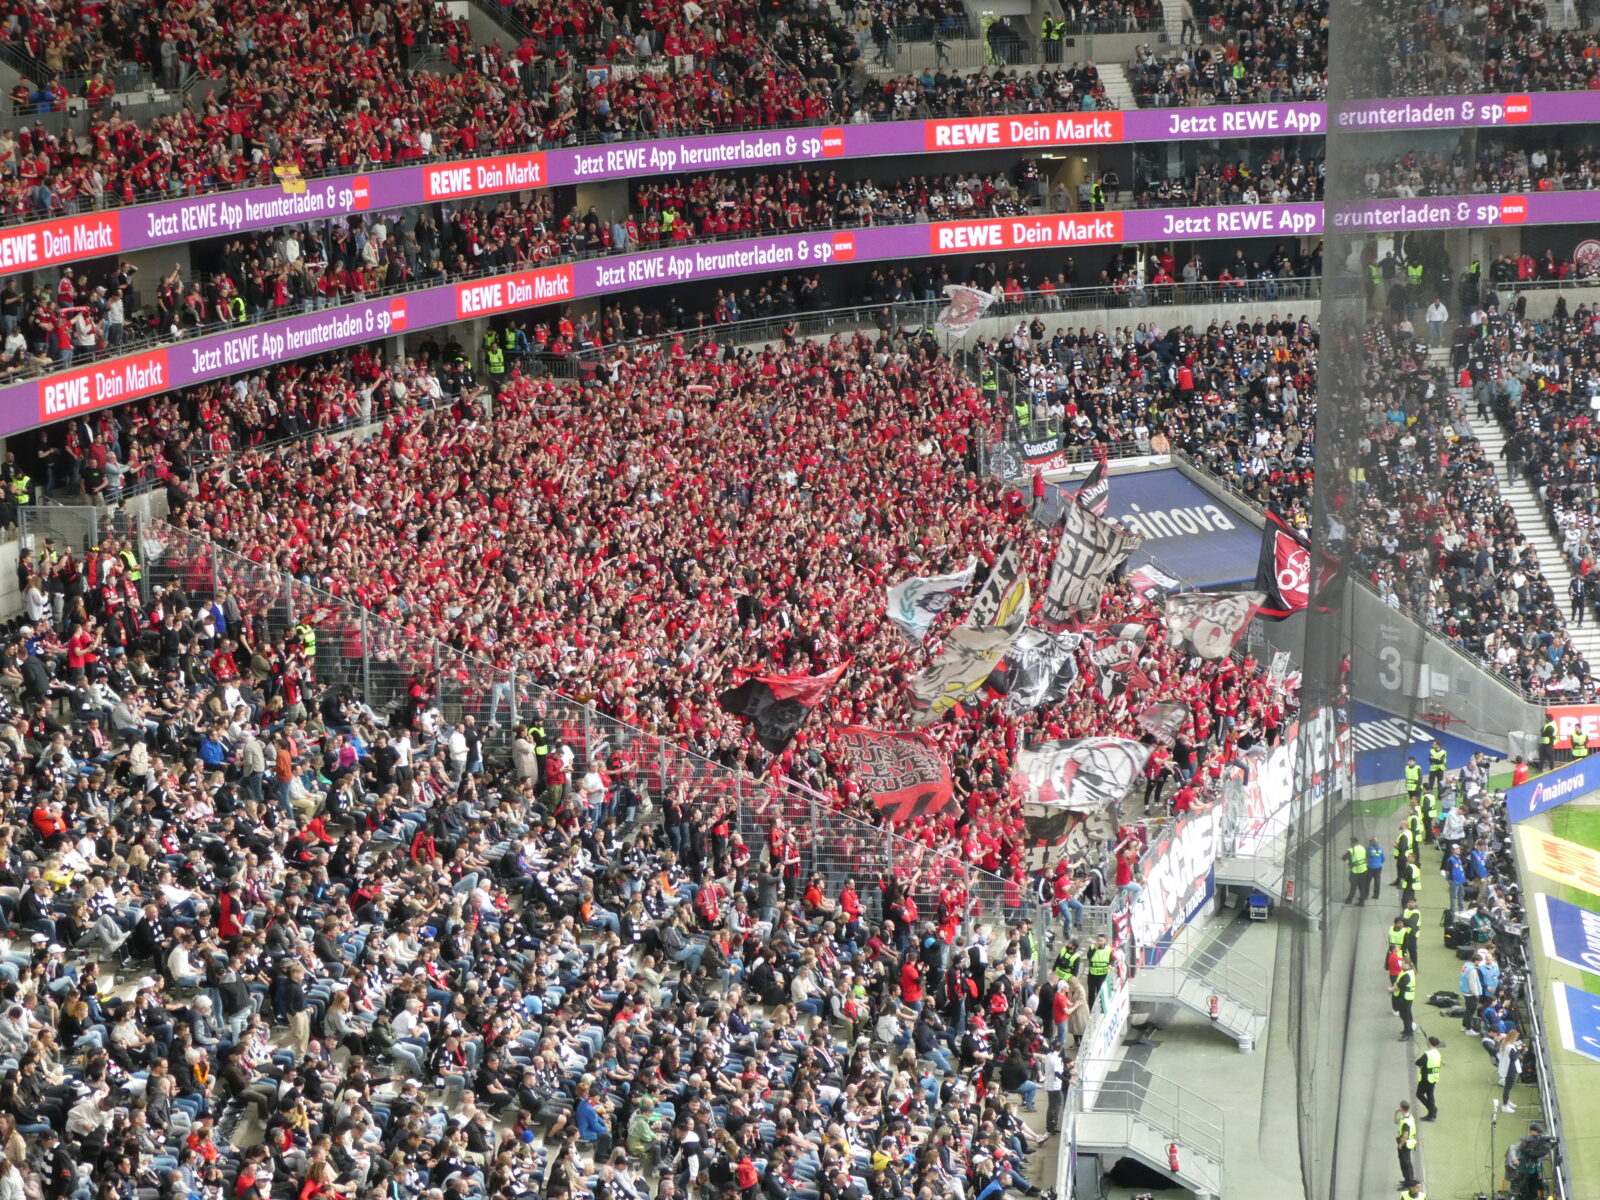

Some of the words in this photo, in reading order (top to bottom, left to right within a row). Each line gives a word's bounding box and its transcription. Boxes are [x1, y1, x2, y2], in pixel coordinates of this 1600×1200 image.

[936, 123, 1000, 146] REWE
[1010, 121, 1050, 142] Dein
[1056, 118, 1112, 139] Markt
[1169, 114, 1217, 134] Jetzt
[1223, 110, 1279, 131] REWE
[1284, 109, 1321, 133] App
[1337, 103, 1455, 127] erunterladen
[1461, 101, 1475, 120] &
[1481, 104, 1505, 124] sp
[574, 155, 604, 175] Jetzt
[607, 148, 647, 171] REWE
[650, 147, 677, 171] App
[680, 138, 781, 164] herunterladen
[785, 135, 797, 155] &
[801, 138, 823, 158] sp
[824, 138, 842, 147] REWE
[354, 189, 368, 197] REWE
[430, 168, 472, 195] REWE
[477, 165, 503, 189] Dein
[506, 161, 540, 185] Markt
[148, 213, 179, 237] Jetzt
[181, 203, 218, 232] REWE
[220, 201, 243, 230] App
[245, 187, 324, 221] herunterladen
[327, 185, 336, 208] &
[339, 188, 354, 211] sp
[1163, 215, 1211, 234] Jetzt
[1217, 210, 1274, 231] REWE
[1279, 210, 1316, 233] App
[1322, 204, 1451, 227] erunterladen
[1457, 202, 1471, 221] &
[1477, 205, 1501, 223] sp
[44, 230, 71, 258] Dein
[74, 222, 112, 254] Markt
[835, 242, 853, 251] REWE
[939, 225, 1003, 249] REWE
[1012, 222, 1052, 244] Dein
[1058, 219, 1114, 240] Markt
[596, 266, 626, 287] Jetzt
[628, 257, 665, 286] REWE
[668, 256, 693, 279] App
[696, 244, 793, 273] herunterladen
[798, 240, 809, 260] &
[813, 242, 834, 263] sp
[461, 284, 502, 313] REWE
[507, 280, 532, 304] Dein
[535, 273, 569, 299] Markt
[392, 309, 405, 319] REWE
[192, 348, 222, 374] Jetzt
[224, 334, 260, 365] REWE
[261, 332, 284, 360] App
[286, 314, 363, 350] herunterladen
[365, 309, 374, 332] &
[377, 310, 392, 334] sp
[45, 376, 90, 415] REWE
[96, 368, 123, 400] Dein
[127, 360, 163, 395] Markt
[1379, 646, 1401, 690] 3
[1559, 716, 1600, 741] RE
[1542, 773, 1585, 802] mainova
